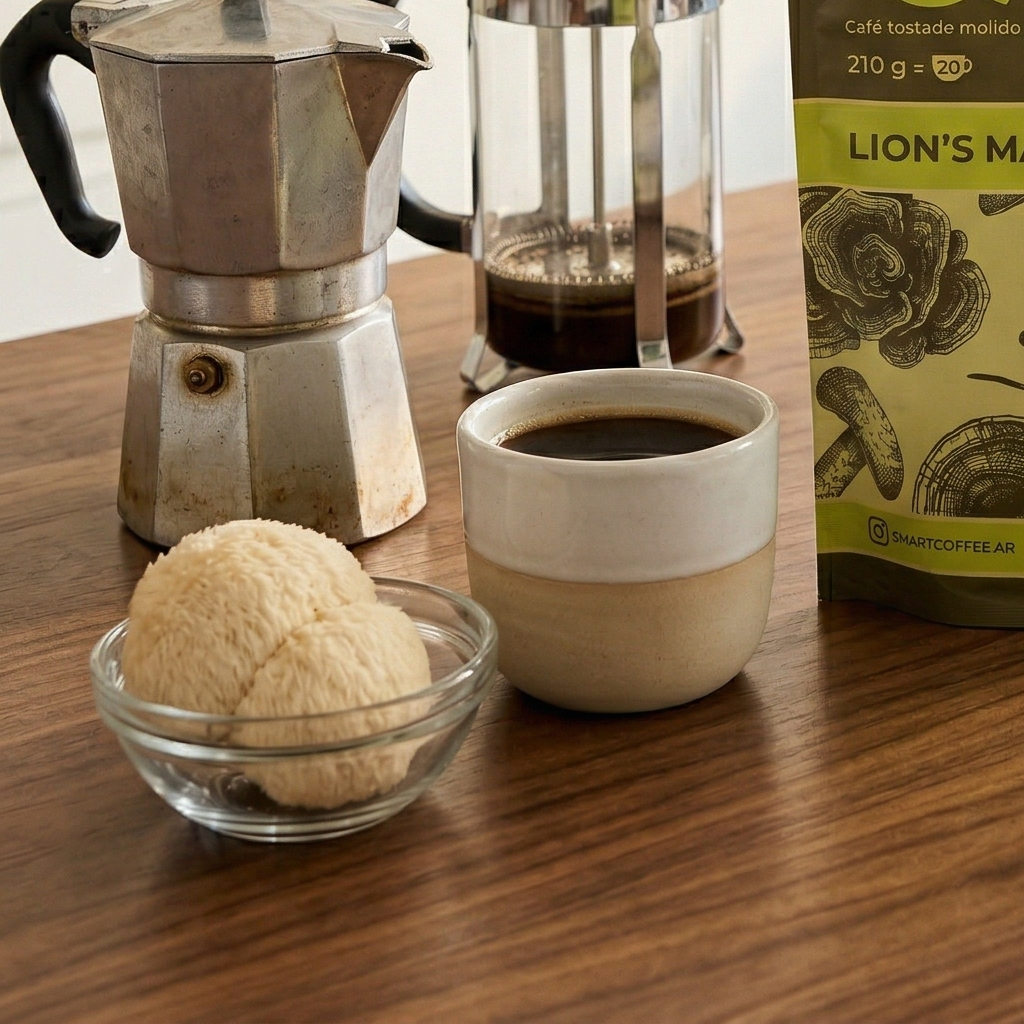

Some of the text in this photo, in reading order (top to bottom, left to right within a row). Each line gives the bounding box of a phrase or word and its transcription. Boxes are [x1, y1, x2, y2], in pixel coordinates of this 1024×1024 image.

[845, 19, 883, 35] Café
[887, 20, 955, 35] tostade
[959, 19, 1021, 35] molido
[847, 55, 885, 74] 210
[891, 60, 906, 80] g
[936, 60, 961, 75] 20
[849, 132, 974, 162] LION'S
